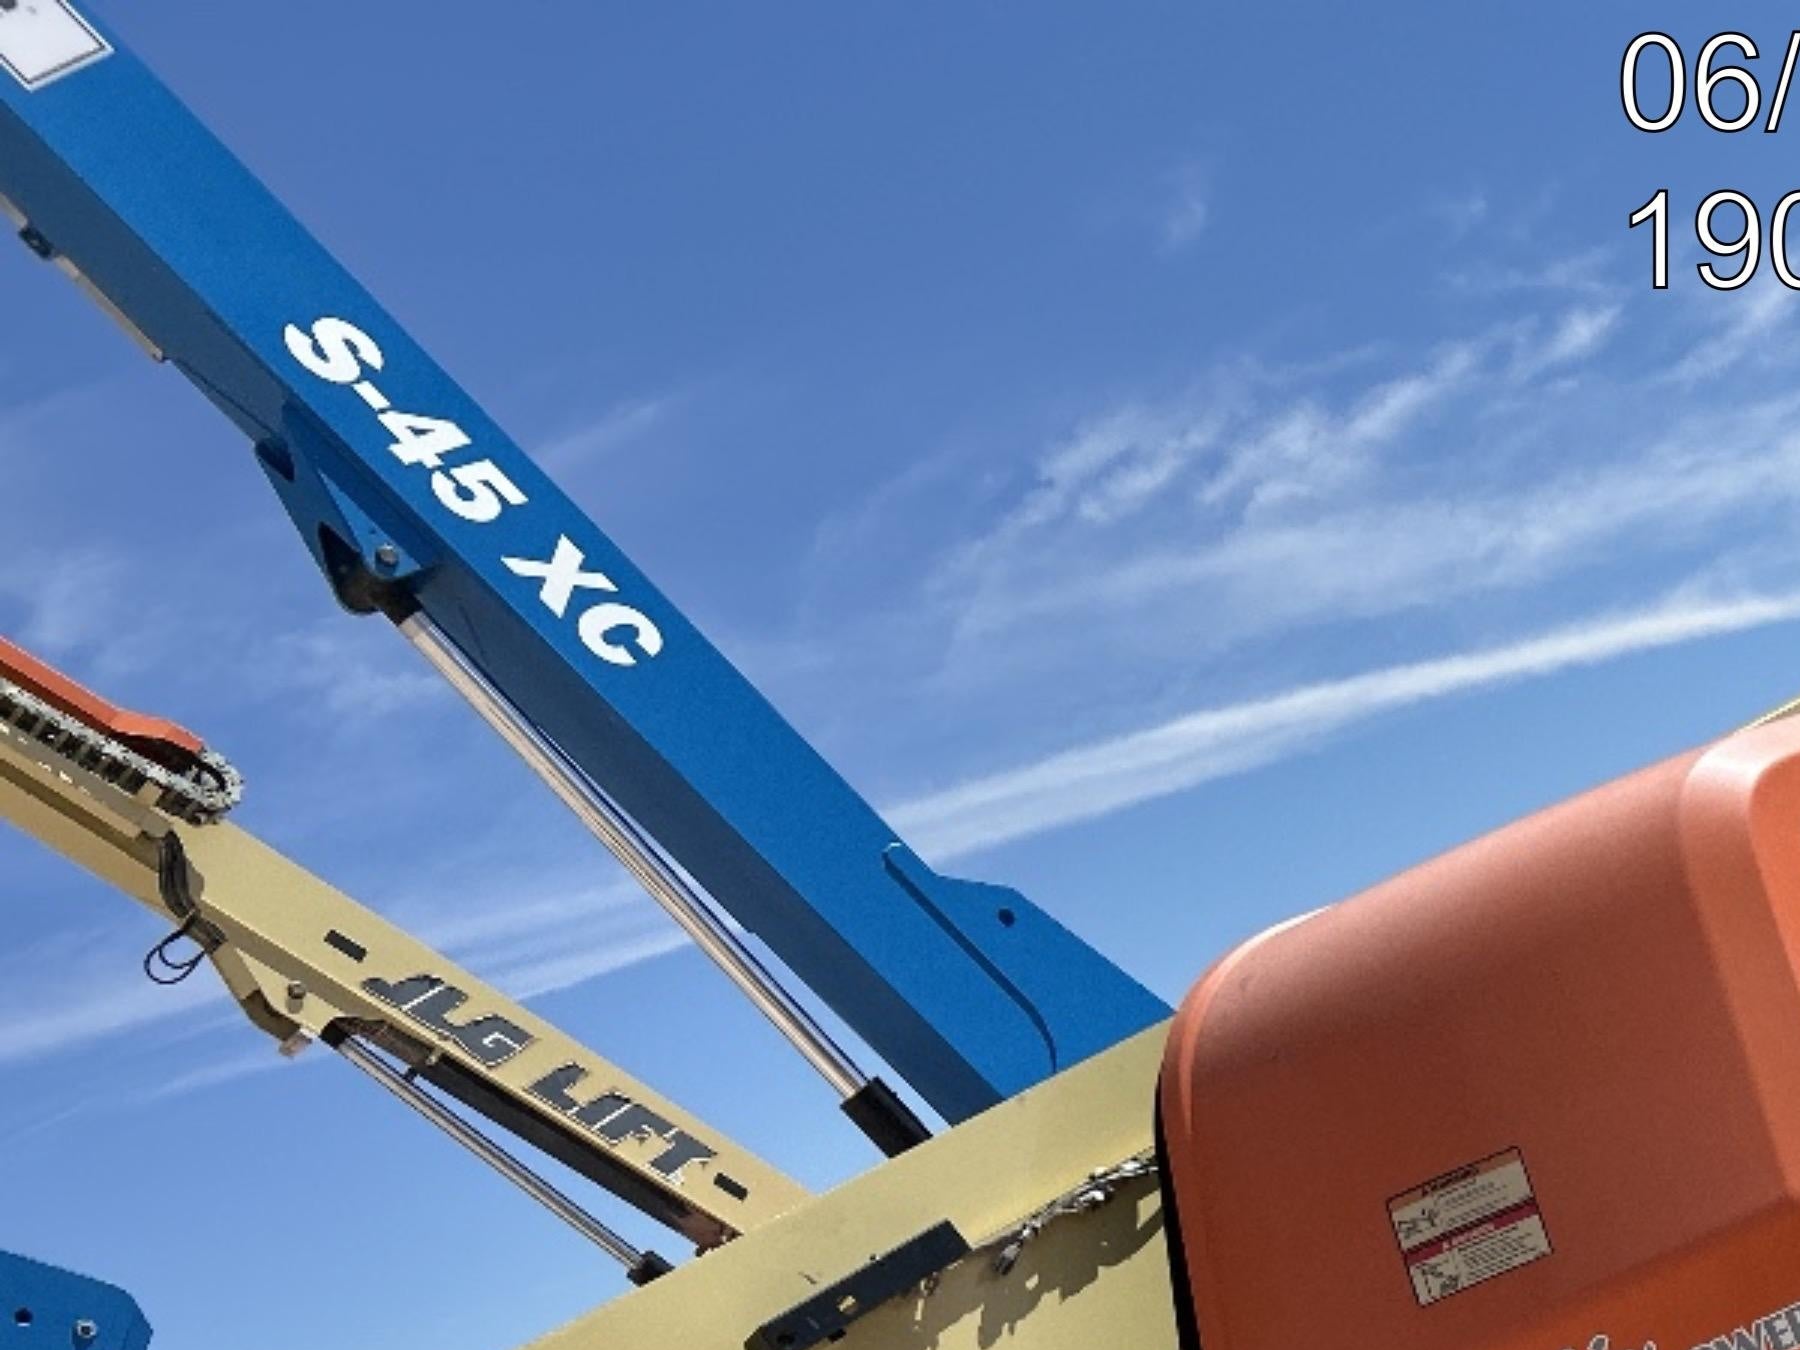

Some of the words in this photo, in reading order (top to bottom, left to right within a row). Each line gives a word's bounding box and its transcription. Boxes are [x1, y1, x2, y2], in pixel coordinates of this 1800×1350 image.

[284, 316, 529, 524] S-45
[501, 533, 664, 667] XC
[361, 973, 538, 1067] JLG
[525, 1060, 718, 1187] LIFT
